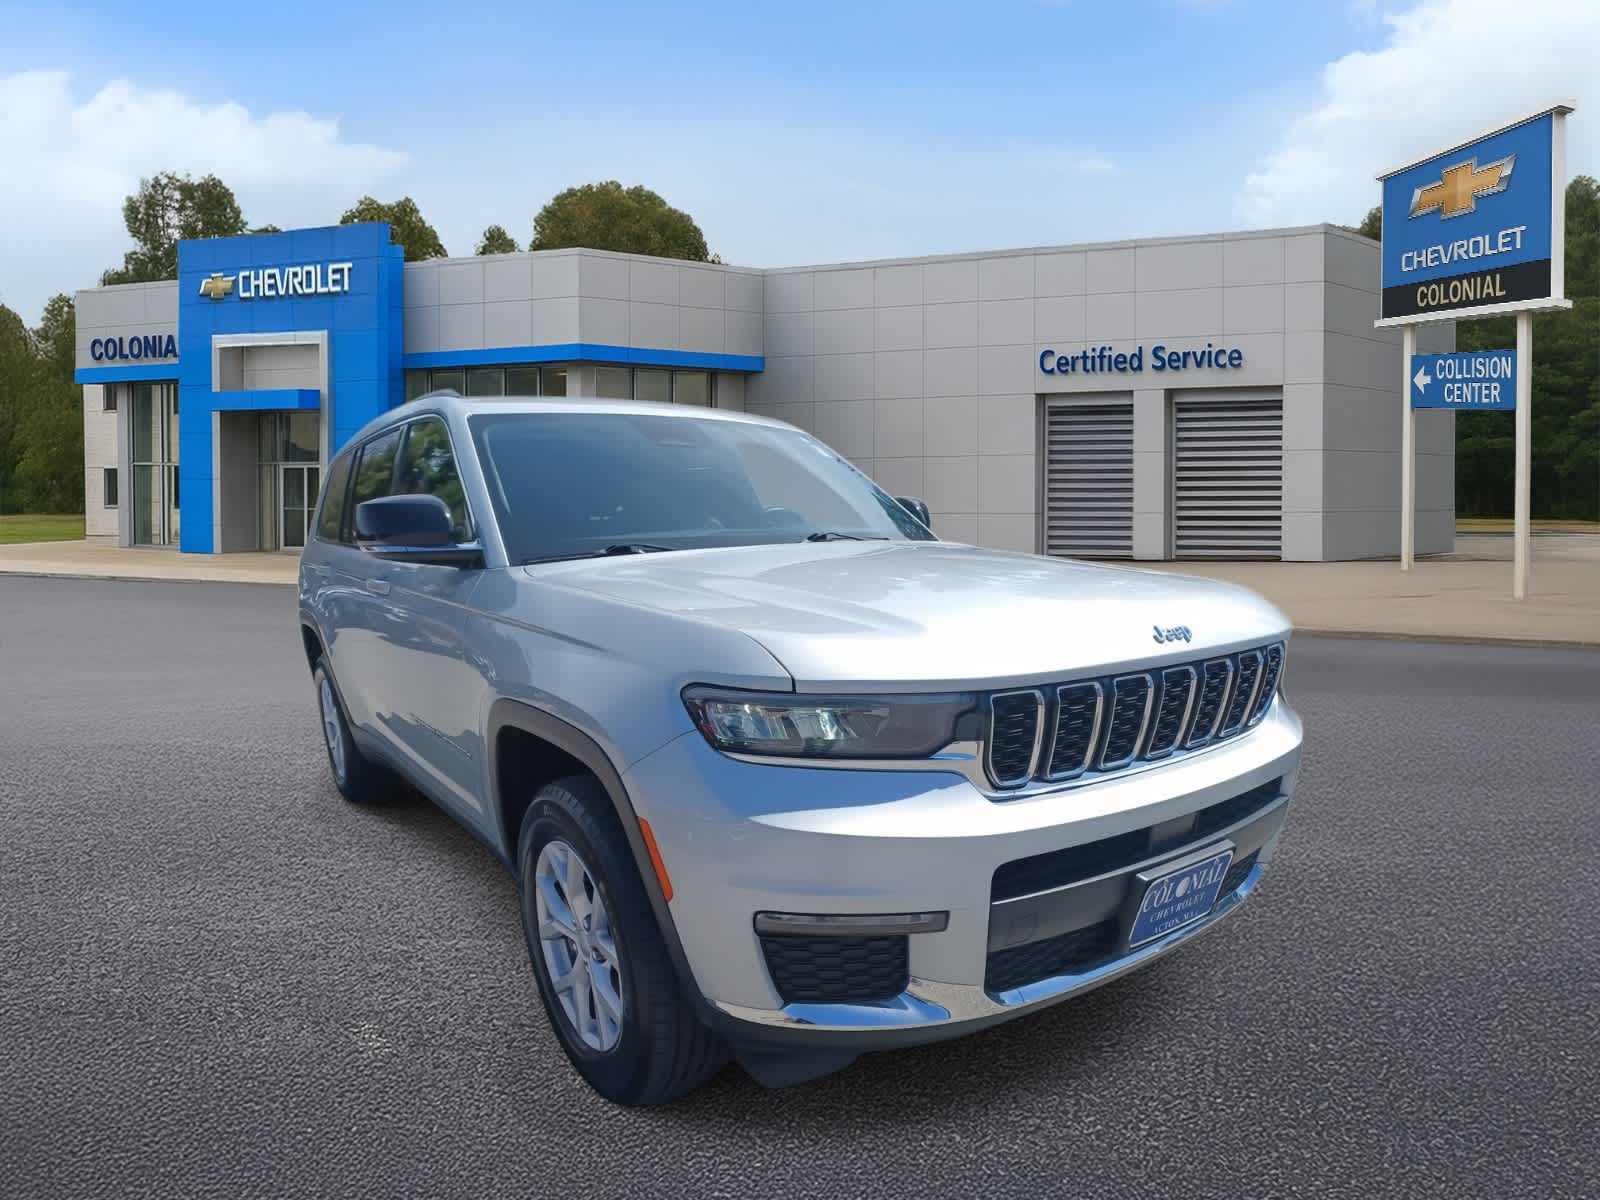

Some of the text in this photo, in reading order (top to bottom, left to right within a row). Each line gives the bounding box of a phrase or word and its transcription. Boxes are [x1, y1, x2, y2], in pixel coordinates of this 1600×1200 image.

[1401, 225, 1527, 273] CHEVROLET
[238, 261, 352, 298] CHEVROLET
[1416, 273, 1506, 307] COLONIAL
[1039, 343, 1243, 374] Certified Service
[1435, 356, 1512, 380] COLLISION
[1444, 382, 1501, 403] CENTER
[1153, 625, 1192, 644] Jeep
